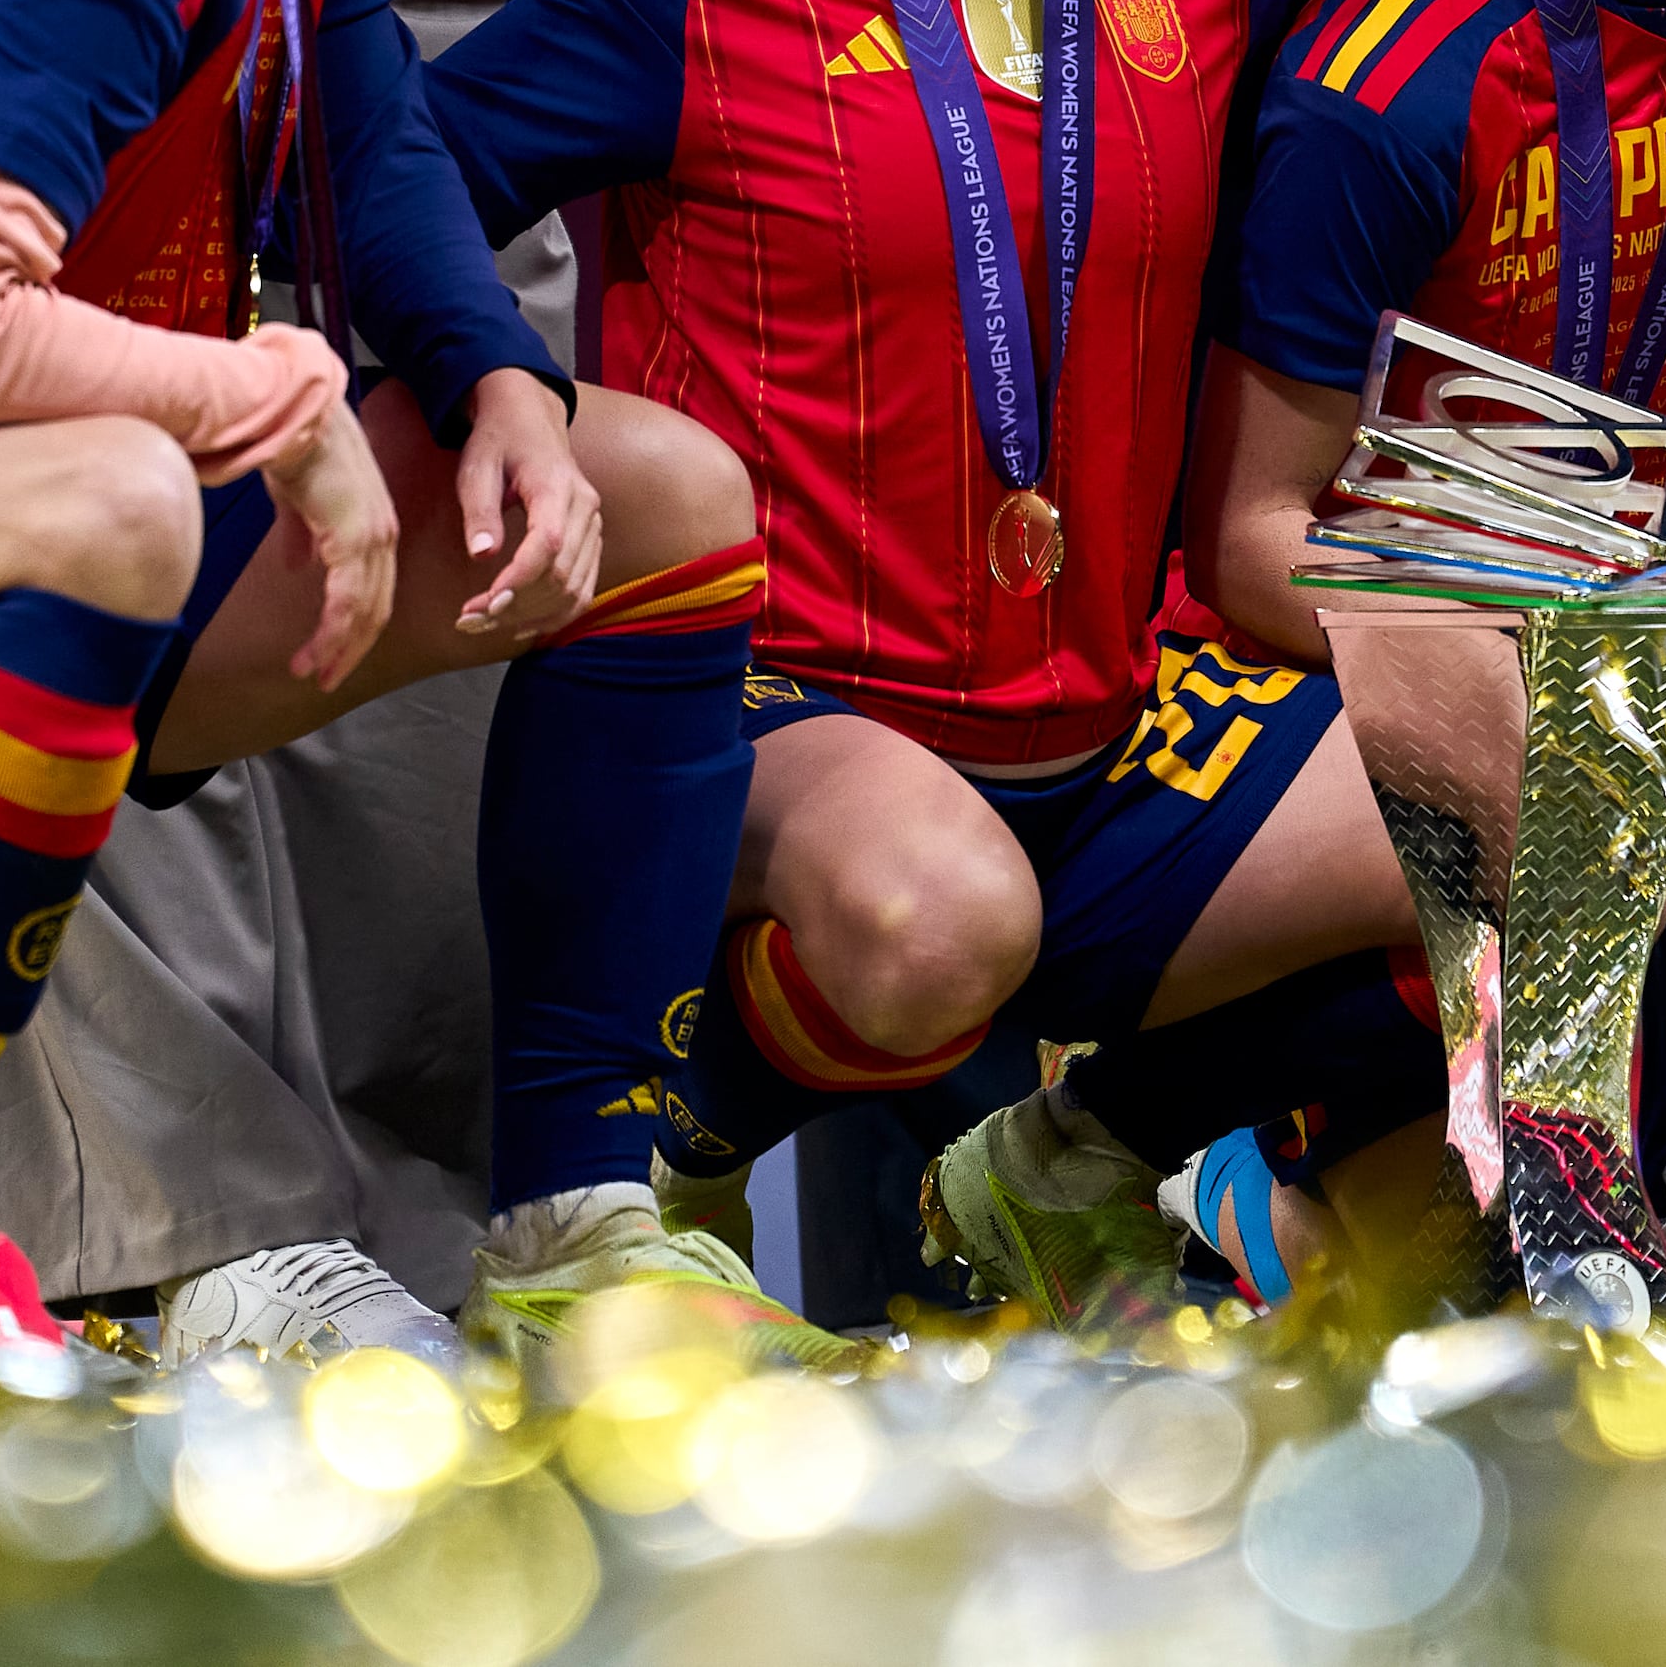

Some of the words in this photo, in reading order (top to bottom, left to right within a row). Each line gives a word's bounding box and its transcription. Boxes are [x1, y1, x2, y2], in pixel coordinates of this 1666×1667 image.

[1004, 53, 1043, 72] FIFA
[1060, 40, 1079, 151] WOMEN'S
[946, 104, 986, 200] LEAGUE
[1060, 154, 1078, 262] NATIONS
[970, 201, 999, 313] NATIONS
[1478, 254, 1530, 288] UEFA
[1572, 260, 1596, 349] LEAGUE
[986, 314, 1017, 431] WOMEN'S
[1579, 1257, 1627, 1279] UEFA
